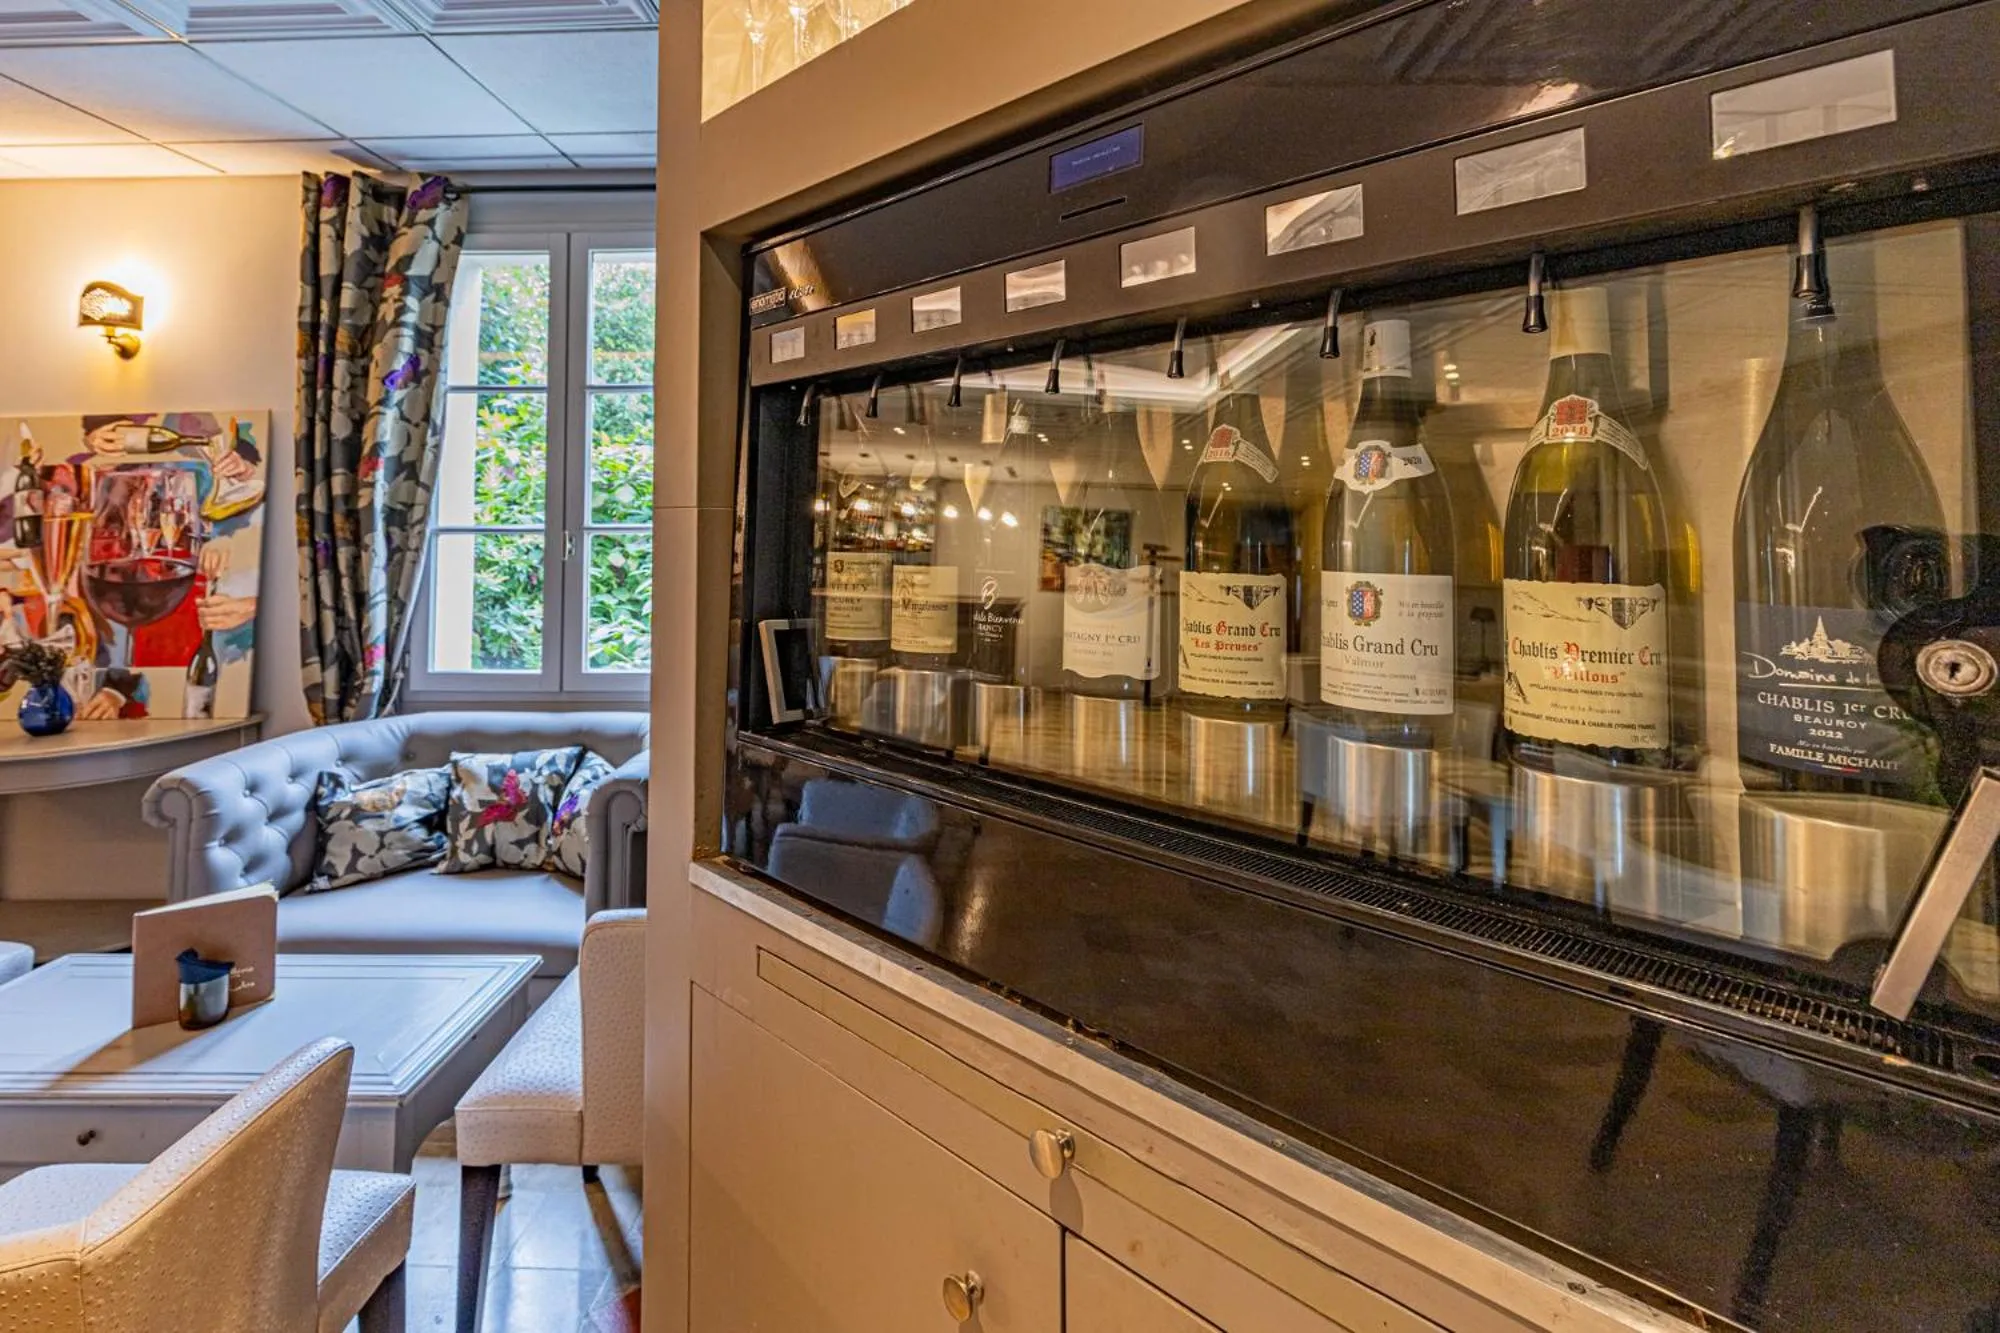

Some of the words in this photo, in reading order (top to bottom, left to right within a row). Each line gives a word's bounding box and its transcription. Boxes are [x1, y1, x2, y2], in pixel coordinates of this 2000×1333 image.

[1215, 620, 1256, 637] Grand
[1259, 622, 1281, 637] Cru
[1352, 635, 1405, 655] Grand
[1410, 640, 1439, 657] Cru
[1511, 637, 1559, 661] Chablis
[1563, 641, 1634, 665] Premier
[1638, 645, 1662, 666] Cru
[1741, 651, 1838, 683] Domaine
[1757, 691, 1836, 714] CHABLIS
[1843, 703, 1867, 716] 1er
[1793, 714, 1869, 731] BEAUROY
[1808, 728, 1844, 740] 2022
[1769, 743, 1826, 763] FAMILLE
